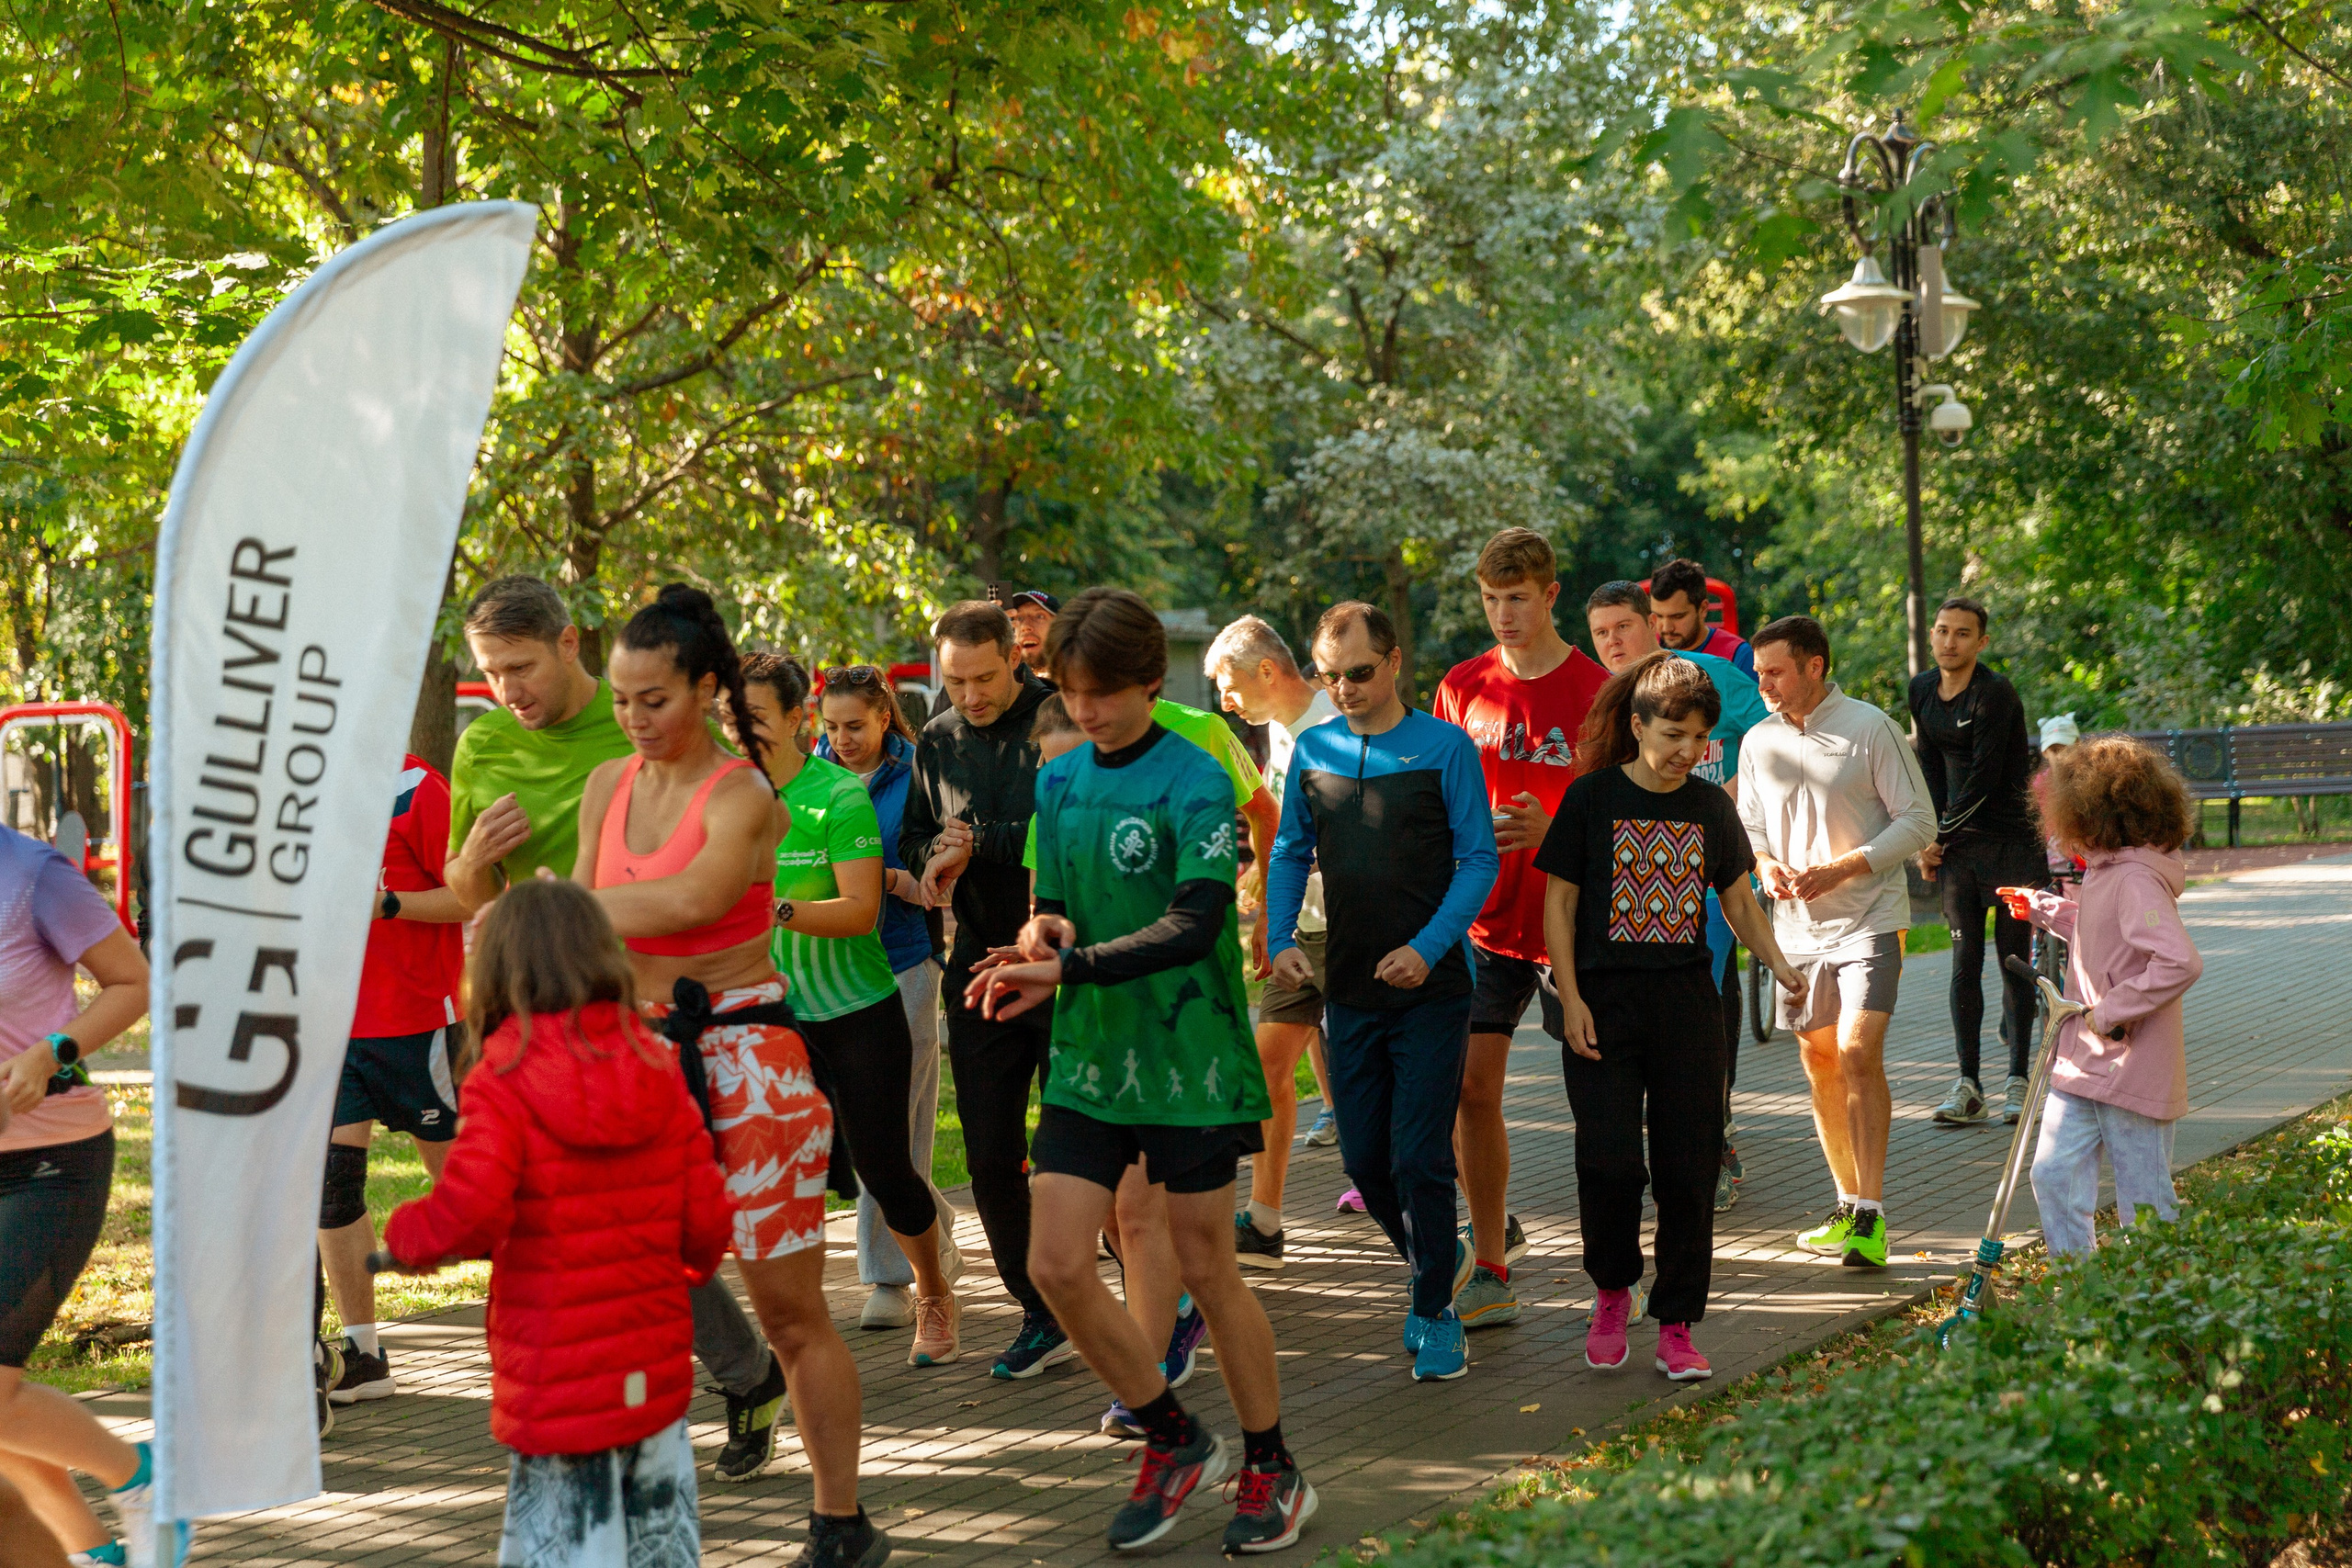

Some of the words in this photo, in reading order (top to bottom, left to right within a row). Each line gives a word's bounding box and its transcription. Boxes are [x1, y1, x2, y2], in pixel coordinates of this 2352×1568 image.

[184, 536, 297, 877] GULLIVER
[269, 645, 342, 884] GROUP
[1471, 721, 1572, 766] FILA
